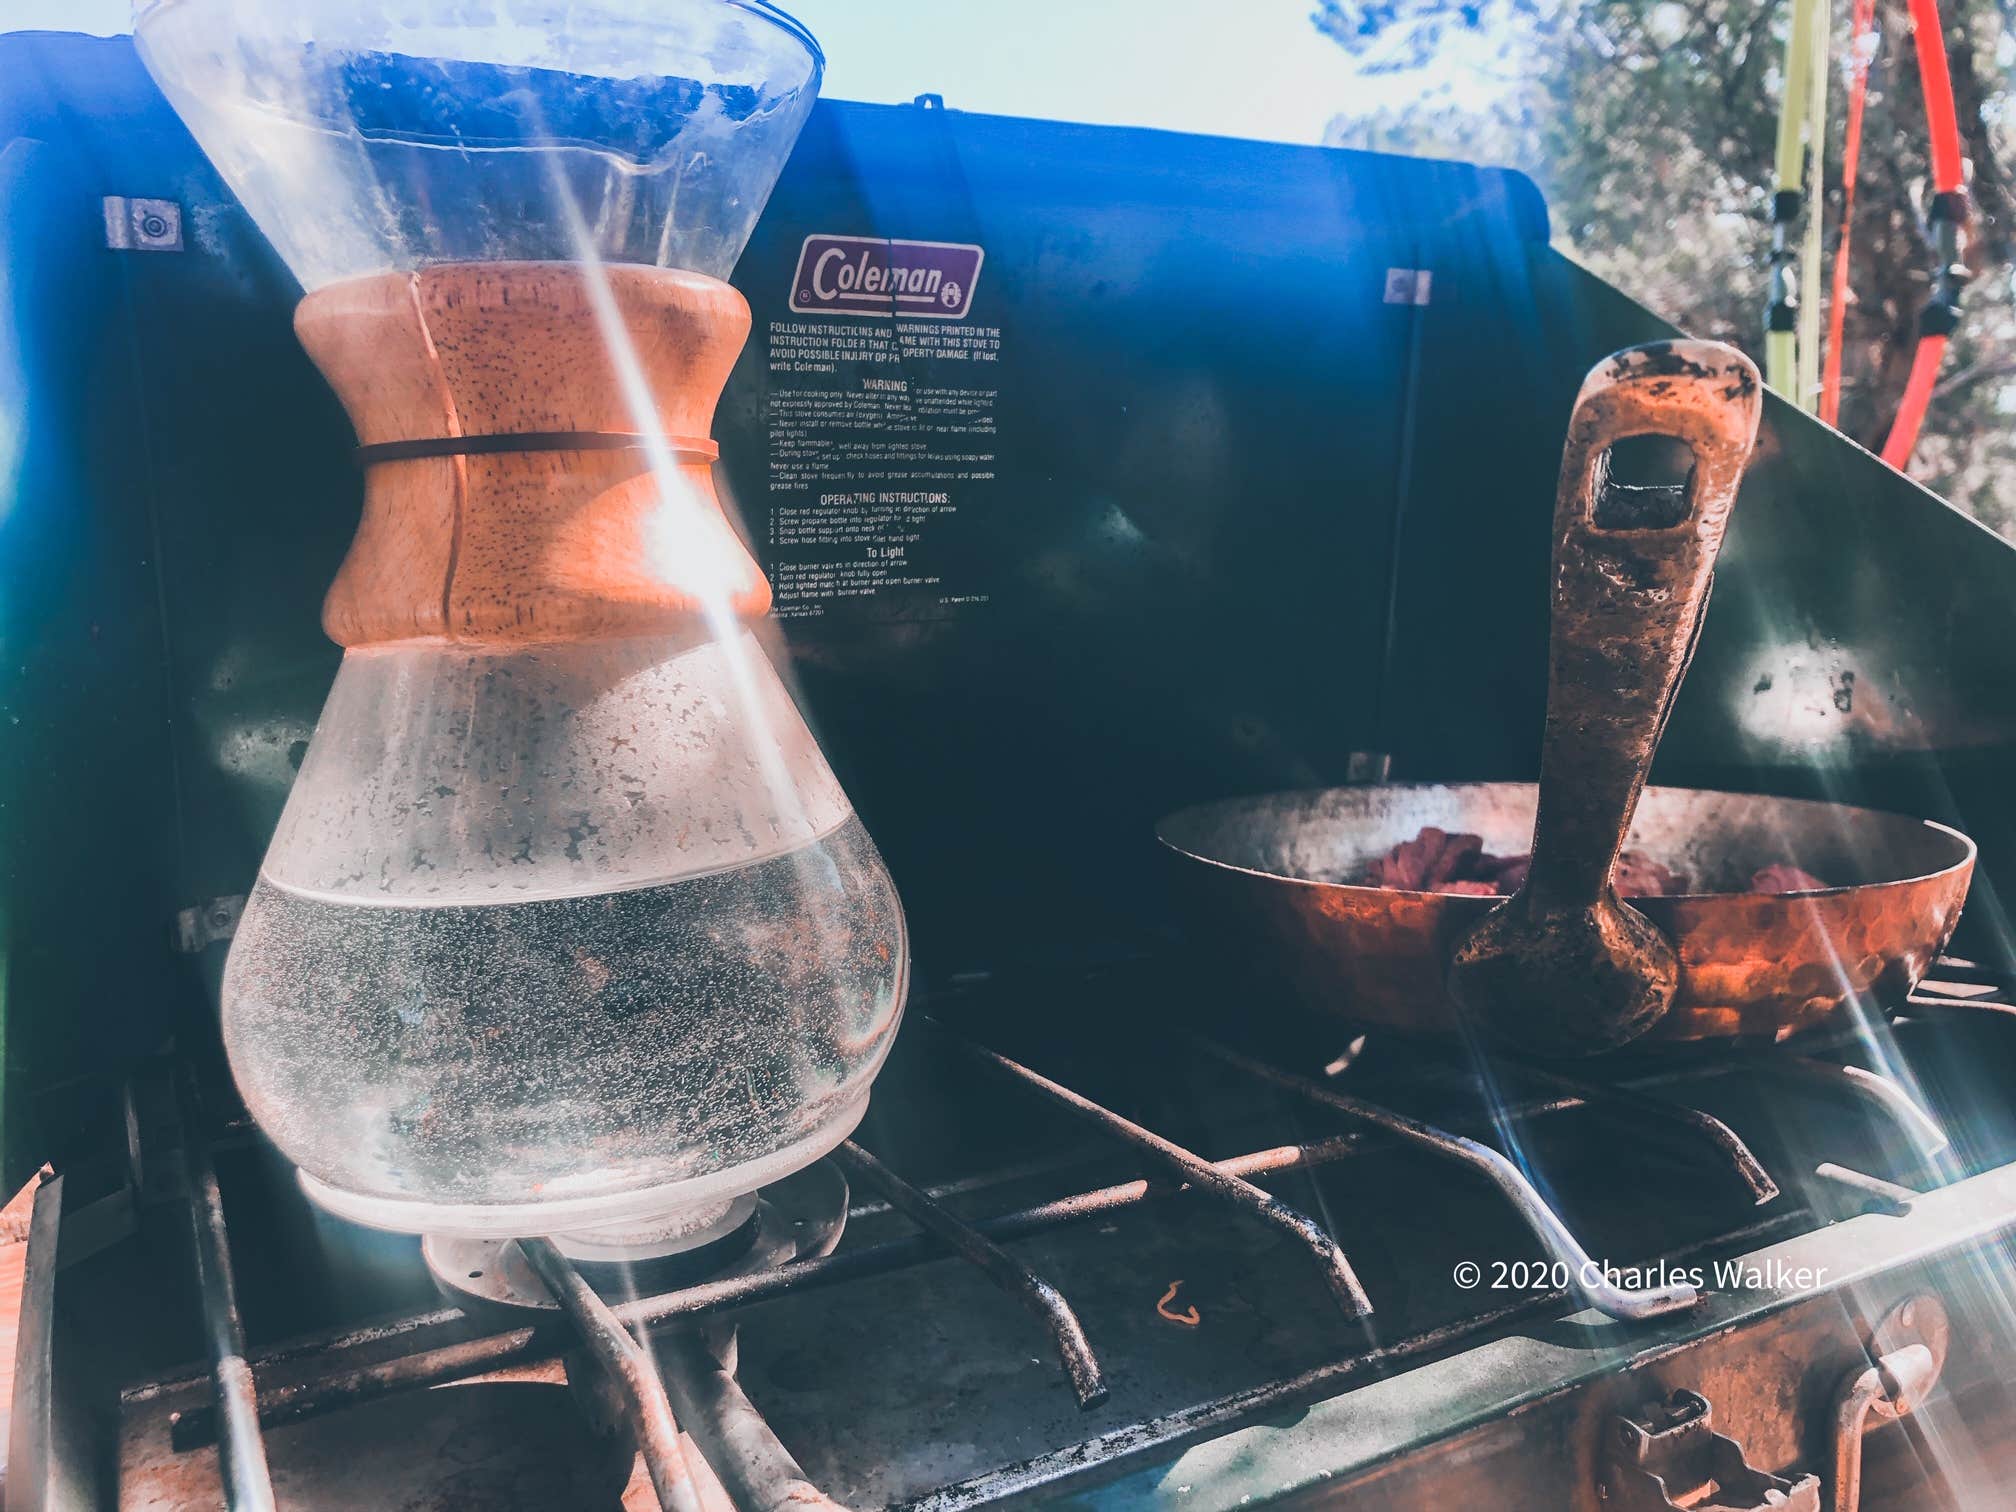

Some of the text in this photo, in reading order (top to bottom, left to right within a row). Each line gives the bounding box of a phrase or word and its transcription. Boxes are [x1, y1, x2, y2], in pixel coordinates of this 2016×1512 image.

[813, 248, 943, 300] Coleman
[770, 322, 1000, 338] FOLLOW INSTRUCTIONS AND WARNINGS PRINTED IN THE
[770, 336, 828, 347] INSTRUCTION
[832, 338, 866, 349] FOLDER
[868, 340, 888, 350] THAT
[920, 336, 940, 347] WITH
[943, 338, 960, 348] THIS
[963, 339, 987, 349] STOVE
[990, 340, 1000, 350] TO
[770, 348, 796, 359] AVOID
[798, 349, 839, 360] POSSIBLE
[842, 351, 873, 361] INJURY
[875, 353, 887, 362] OR
[937, 349, 968, 360] DAMAGE
[770, 362, 838, 374] write Coleman).
[793, 389, 802, 397] for
[803, 390, 829, 399] cooking
[846, 391, 863, 399] Never
[770, 461, 789, 470] Never
[868, 471, 885, 479] avoid
[770, 482, 792, 491] grease
[820, 492, 876, 506] OPERATING
[779, 507, 797, 516] Close
[779, 517, 799, 526] Screw
[779, 536, 799, 545] Screw
[866, 547, 904, 559] To Light
[779, 562, 796, 571] Close
[779, 581, 794, 590] Hold
[779, 591, 799, 600] Adjust
